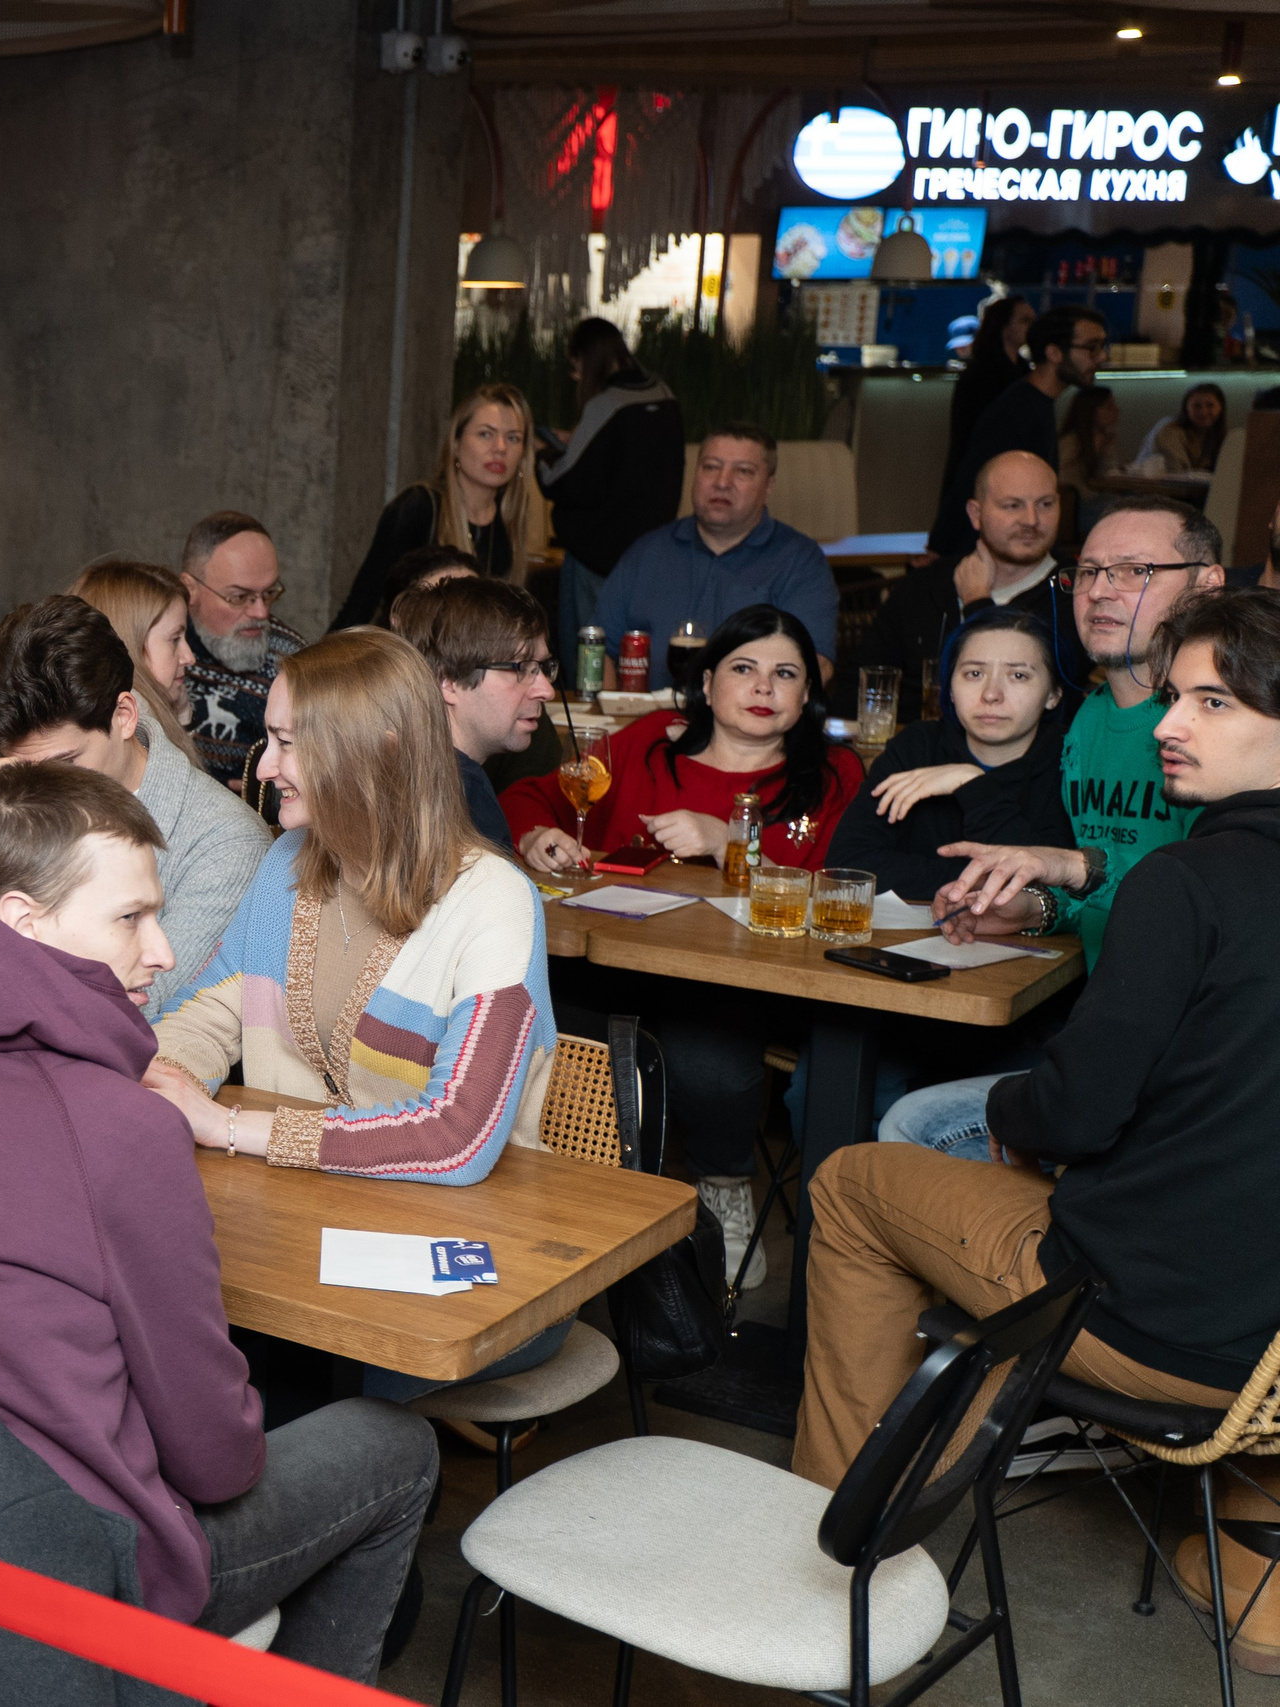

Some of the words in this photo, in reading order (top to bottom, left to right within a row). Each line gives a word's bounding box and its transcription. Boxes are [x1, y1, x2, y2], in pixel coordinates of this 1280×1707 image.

[907, 107, 1204, 162] ГИРО-ГИРОС
[913, 167, 1082, 201] ГРЕЧЕСКАЯ
[1090, 169, 1188, 202] КУХНЯ
